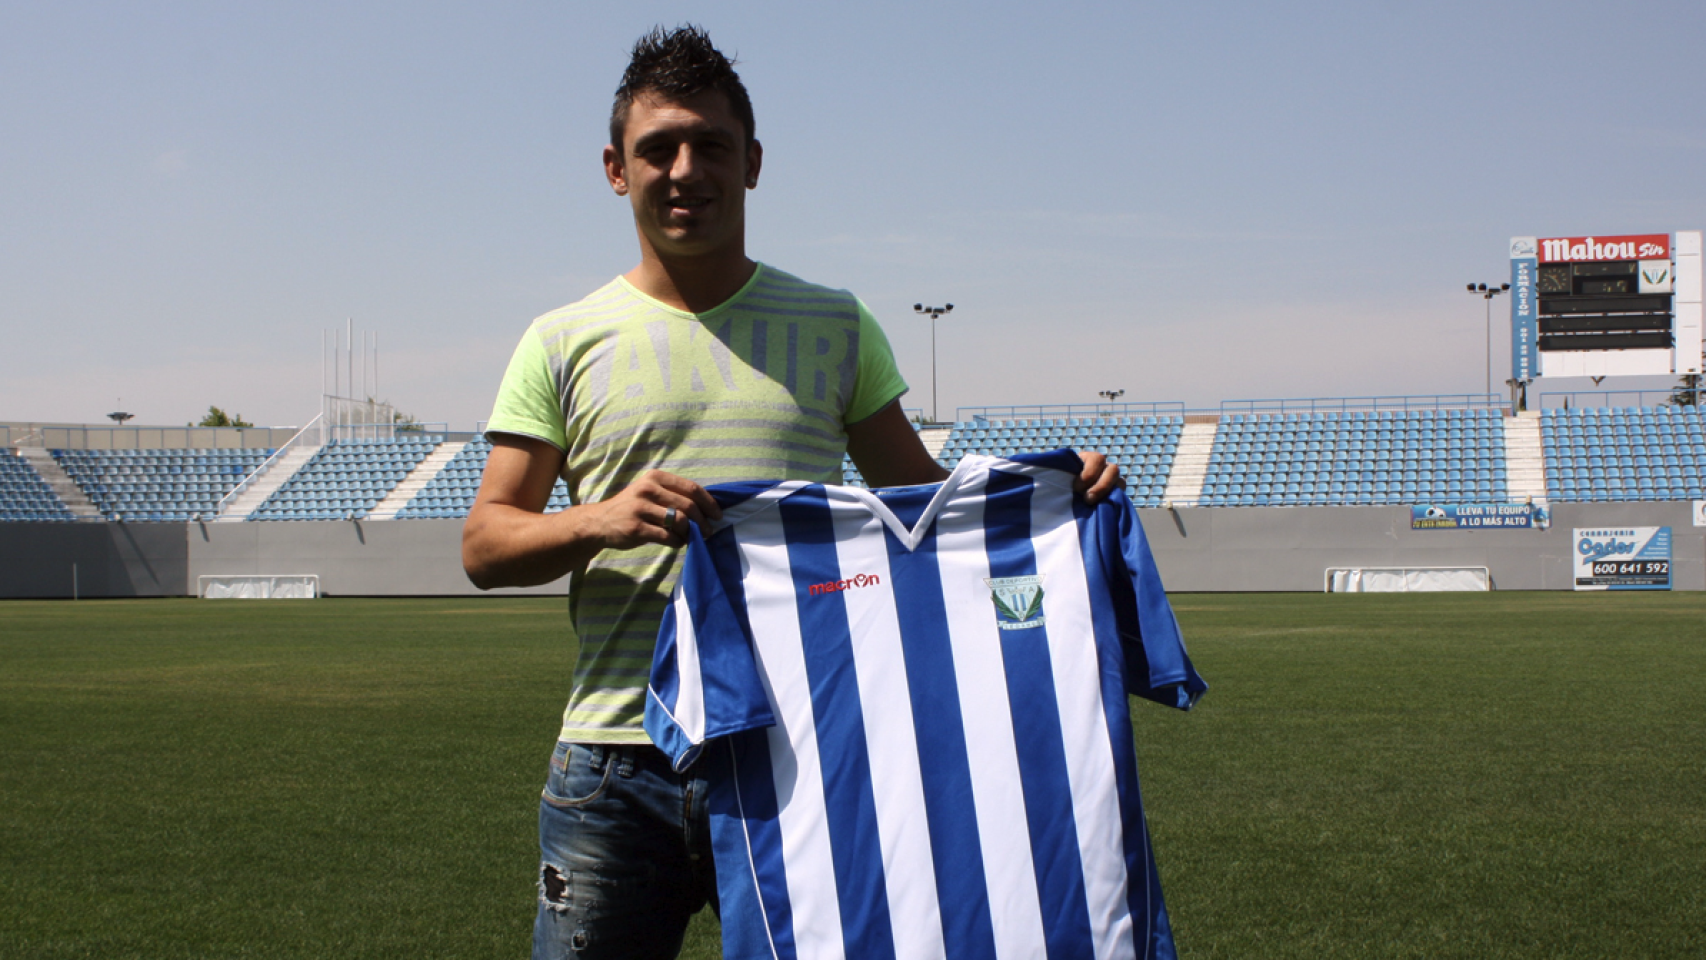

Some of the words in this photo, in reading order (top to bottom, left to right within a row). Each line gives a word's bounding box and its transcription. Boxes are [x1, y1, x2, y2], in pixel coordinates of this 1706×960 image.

[1542, 236, 1636, 262] Mahou
[1456, 506, 1483, 516] LLEVA
[1485, 506, 1497, 515] TU
[1498, 505, 1530, 515] EQUIPO
[1460, 518, 1467, 526] A
[1469, 518, 1481, 526] LO
[1482, 515, 1502, 526] MÁS
[1504, 517, 1527, 526] ALTO
[1594, 563, 1617, 574] 600
[1619, 563, 1642, 573] 641
[1645, 562, 1669, 573] 592
[808, 573, 880, 596] macron
